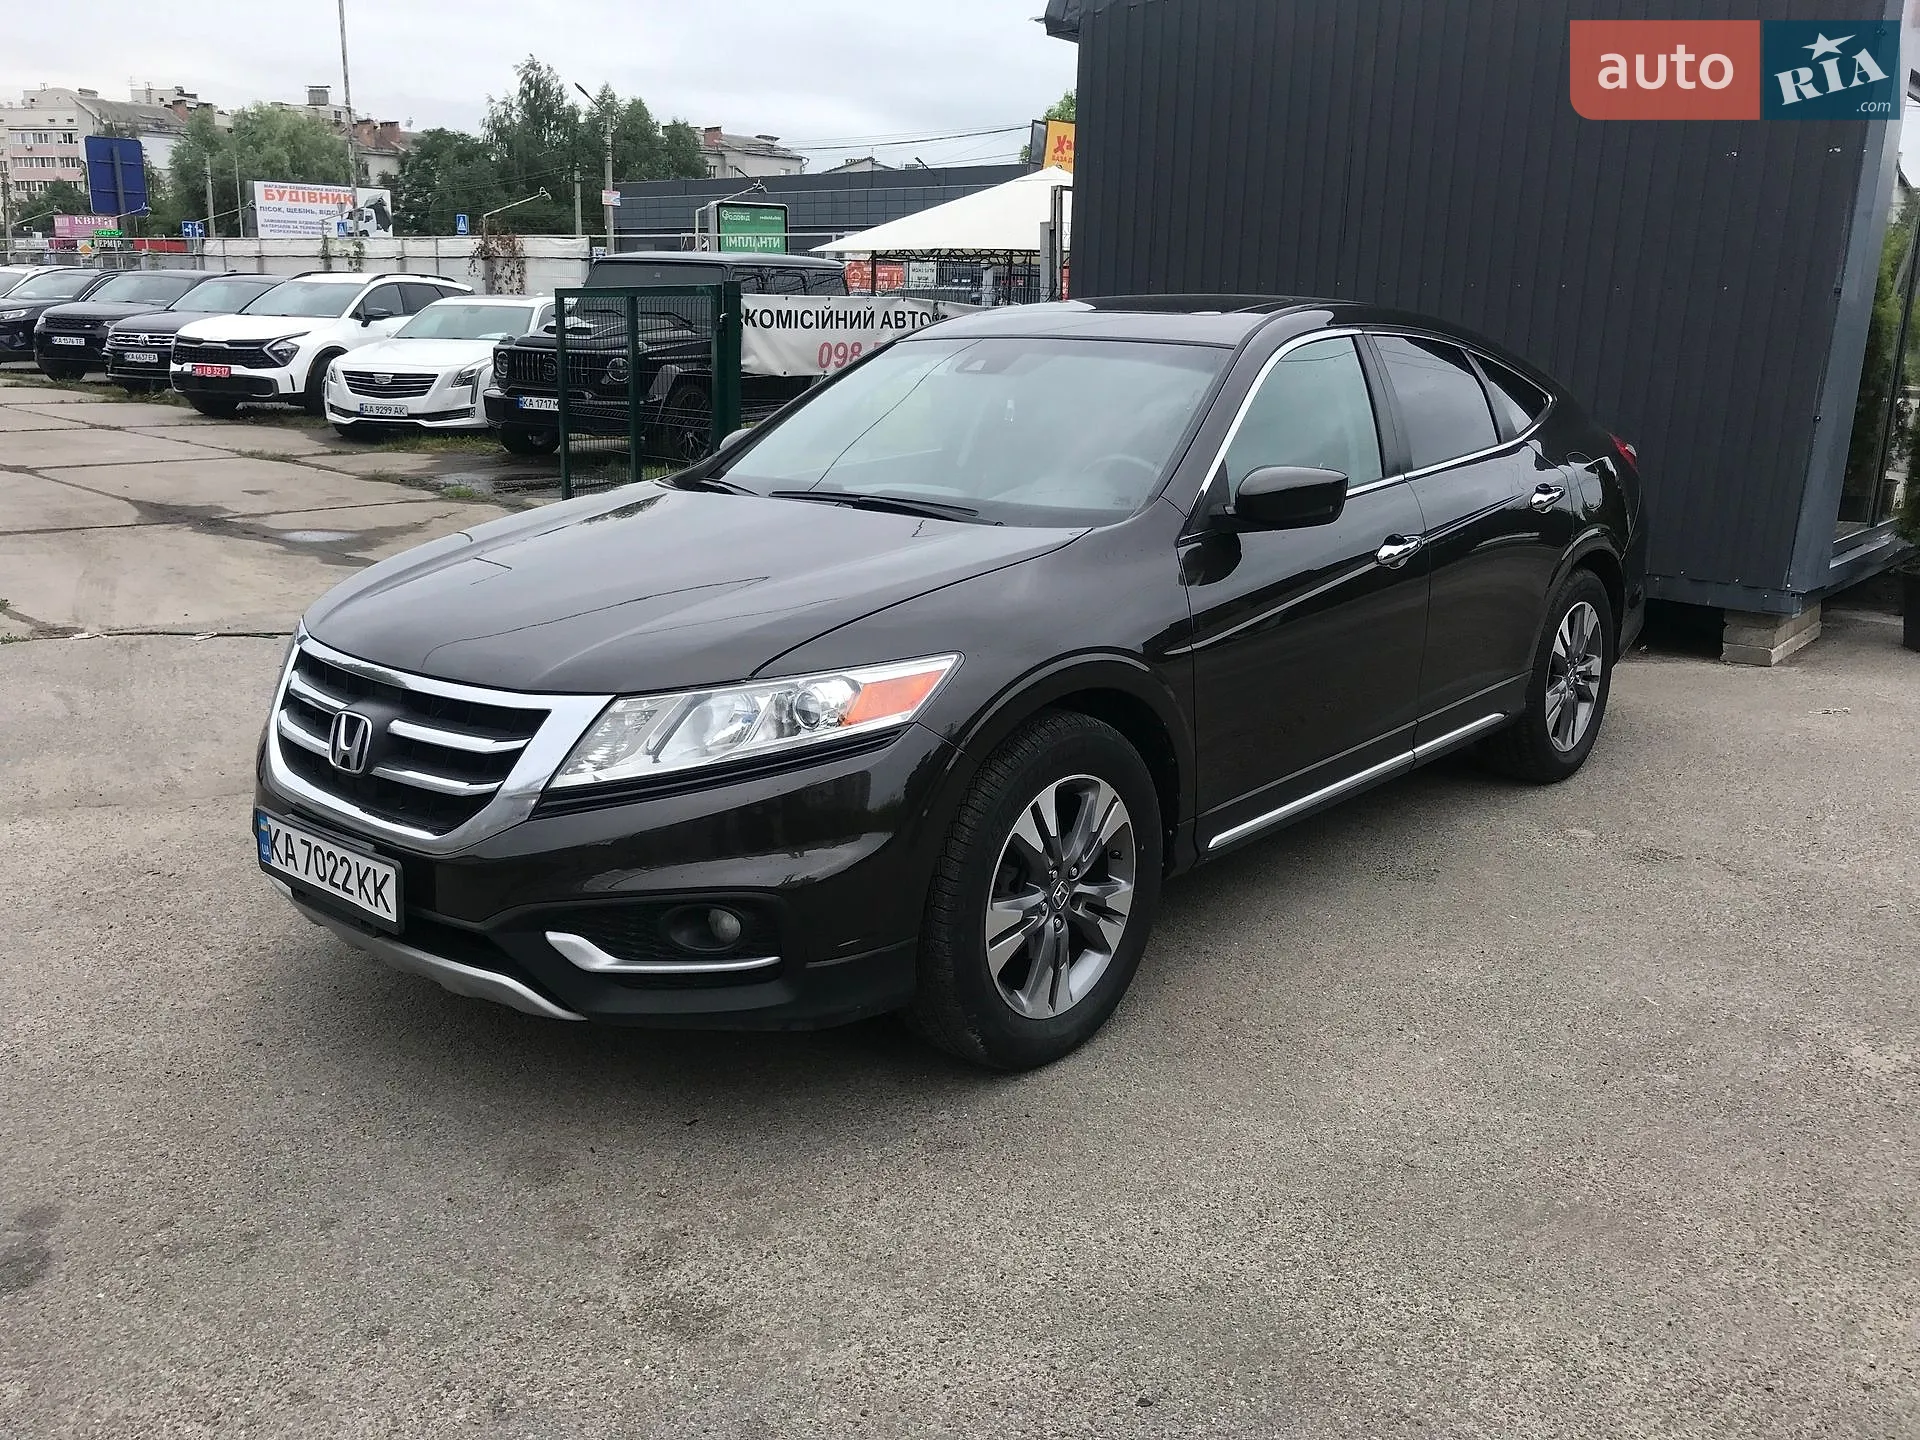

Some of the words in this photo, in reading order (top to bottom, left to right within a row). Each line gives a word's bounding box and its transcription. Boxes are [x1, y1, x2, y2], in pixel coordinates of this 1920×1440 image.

[264, 189, 354, 205] БУДІВНИК
[726, 236, 780, 248] ІМПЛАНТИ
[744, 306, 874, 329] КОМІСІЙНИЙ
[524, 398, 534, 408] KA
[536, 399, 551, 409] 1717
[375, 406, 392, 414] 9299
[394, 407, 405, 415] AK
